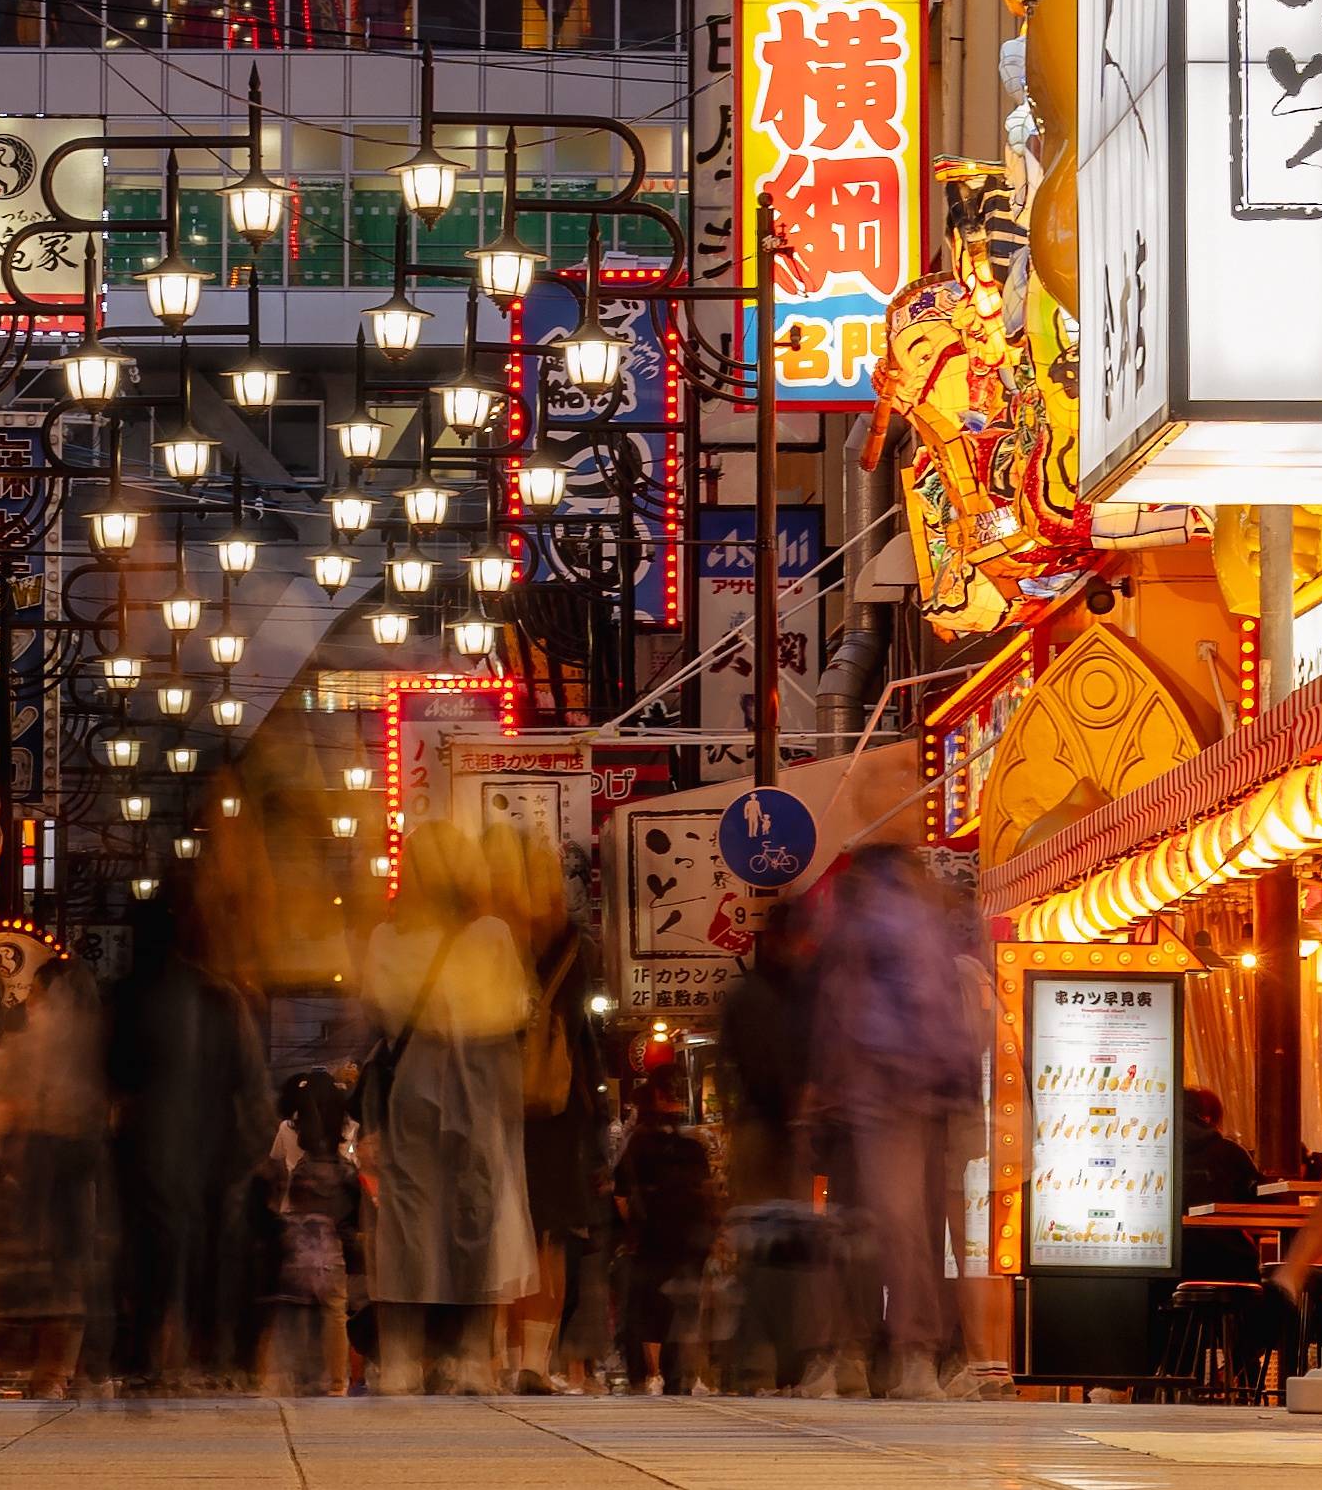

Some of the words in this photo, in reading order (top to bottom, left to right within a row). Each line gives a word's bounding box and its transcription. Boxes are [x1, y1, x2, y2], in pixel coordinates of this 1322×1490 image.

[760, 8, 902, 297] 横綱
[706, 528, 809, 568] Ashi
[633, 968, 651, 982] 1F
[632, 991, 651, 1005] 2F
